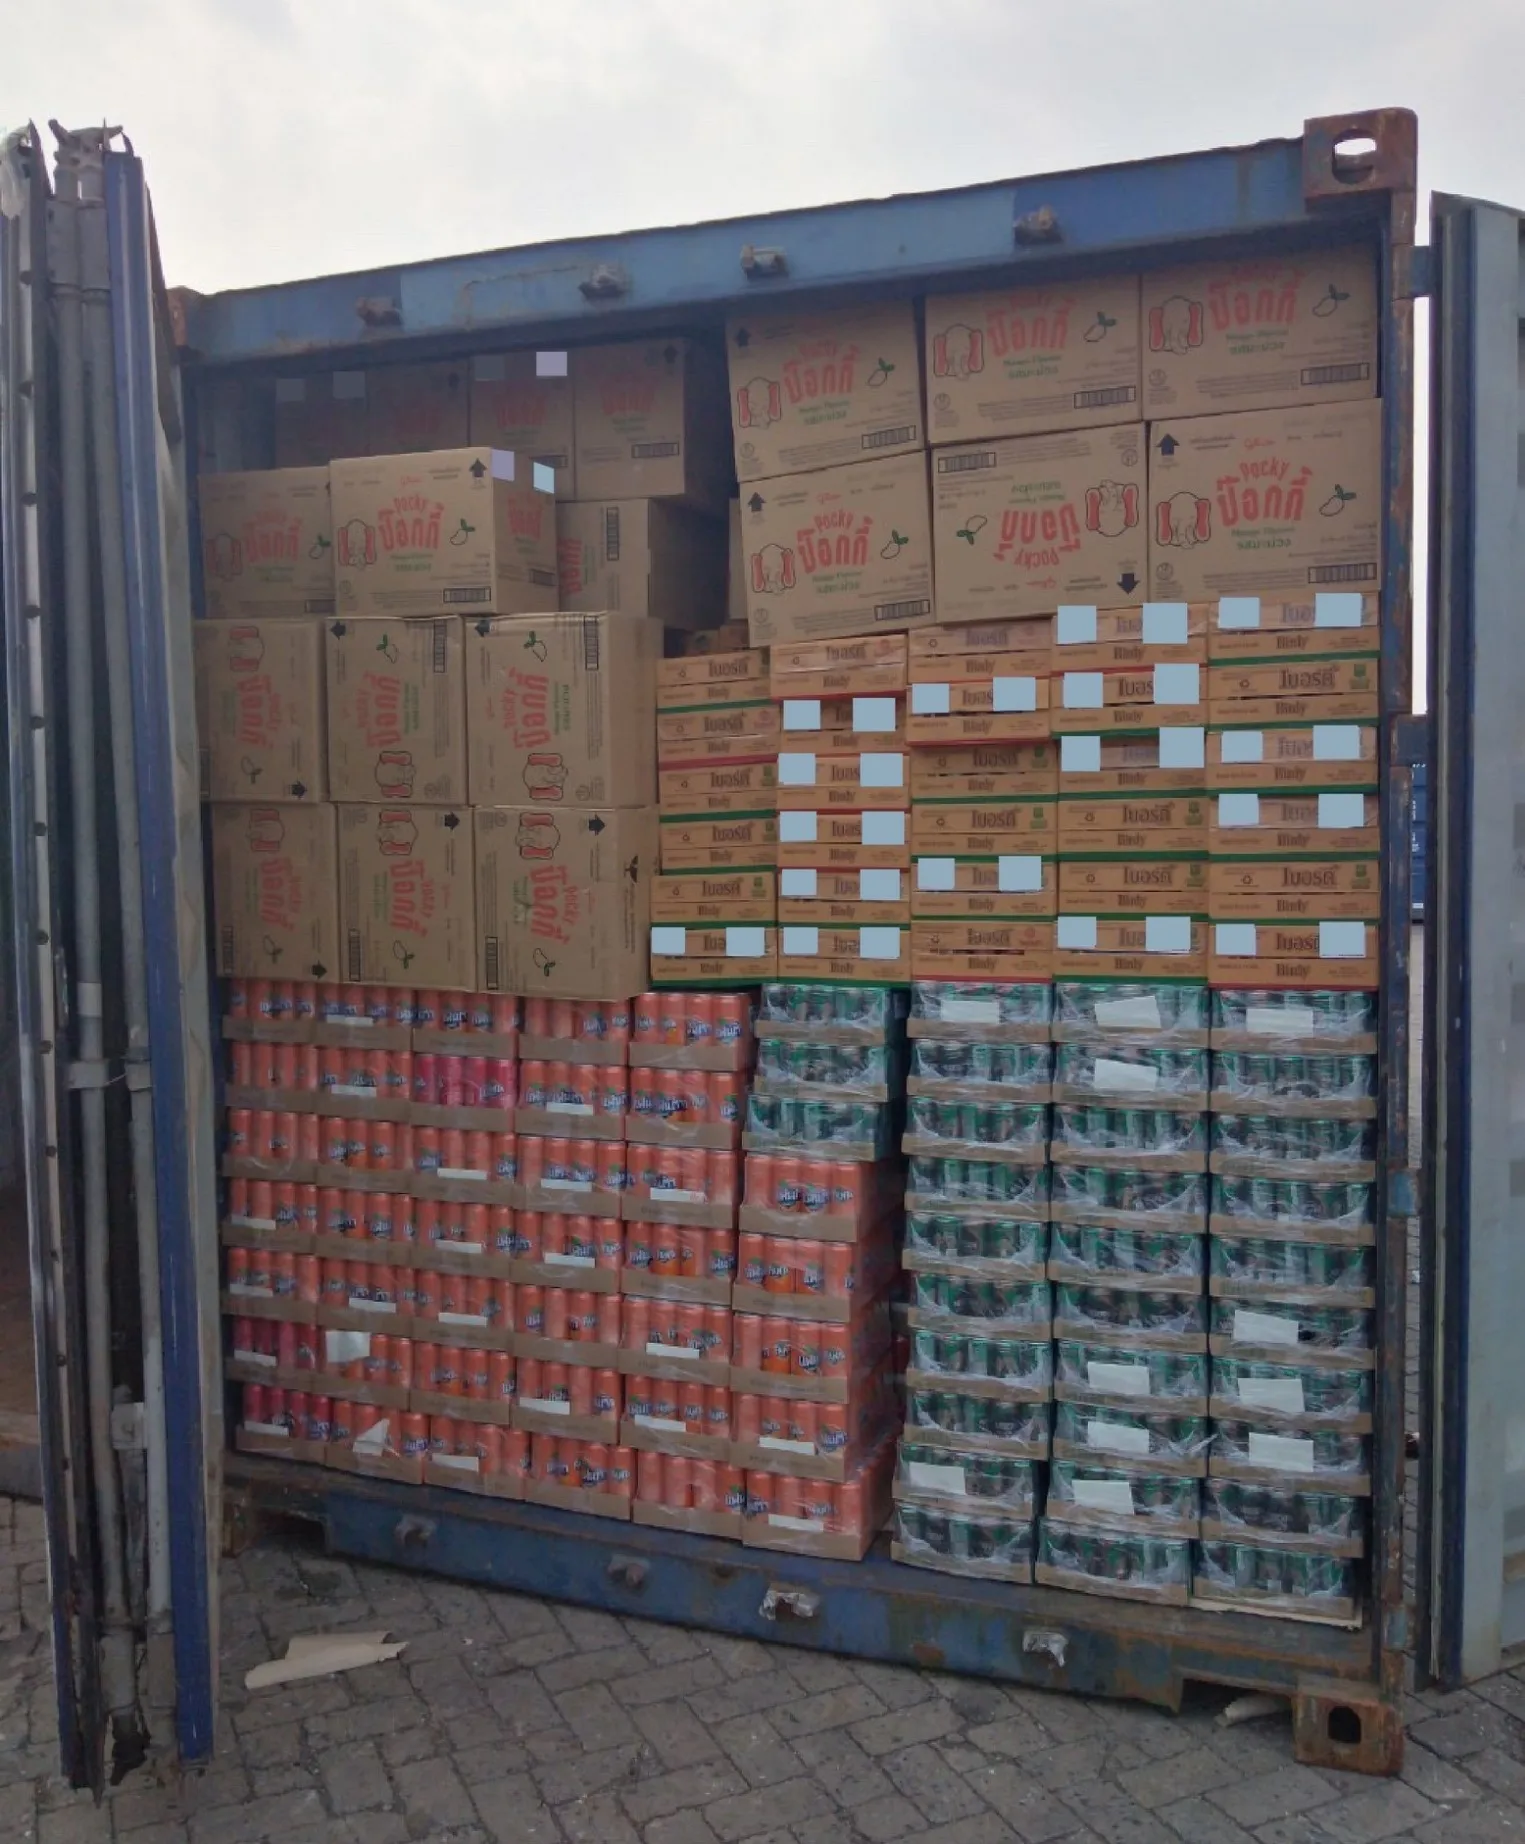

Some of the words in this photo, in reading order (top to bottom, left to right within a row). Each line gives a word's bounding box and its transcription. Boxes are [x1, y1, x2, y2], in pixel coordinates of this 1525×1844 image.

[1216, 466, 1313, 527] ป๊อกกี้
[1239, 456, 1291, 482] Pocky
[377, 502, 445, 551] ป๊อกกี้
[796, 516, 874, 574] ป๊อกกี้
[813, 508, 854, 532] Pocky
[507, 665, 552, 749] ป๊อกกี้
[529, 864, 569, 945] ป๊อกกี้
